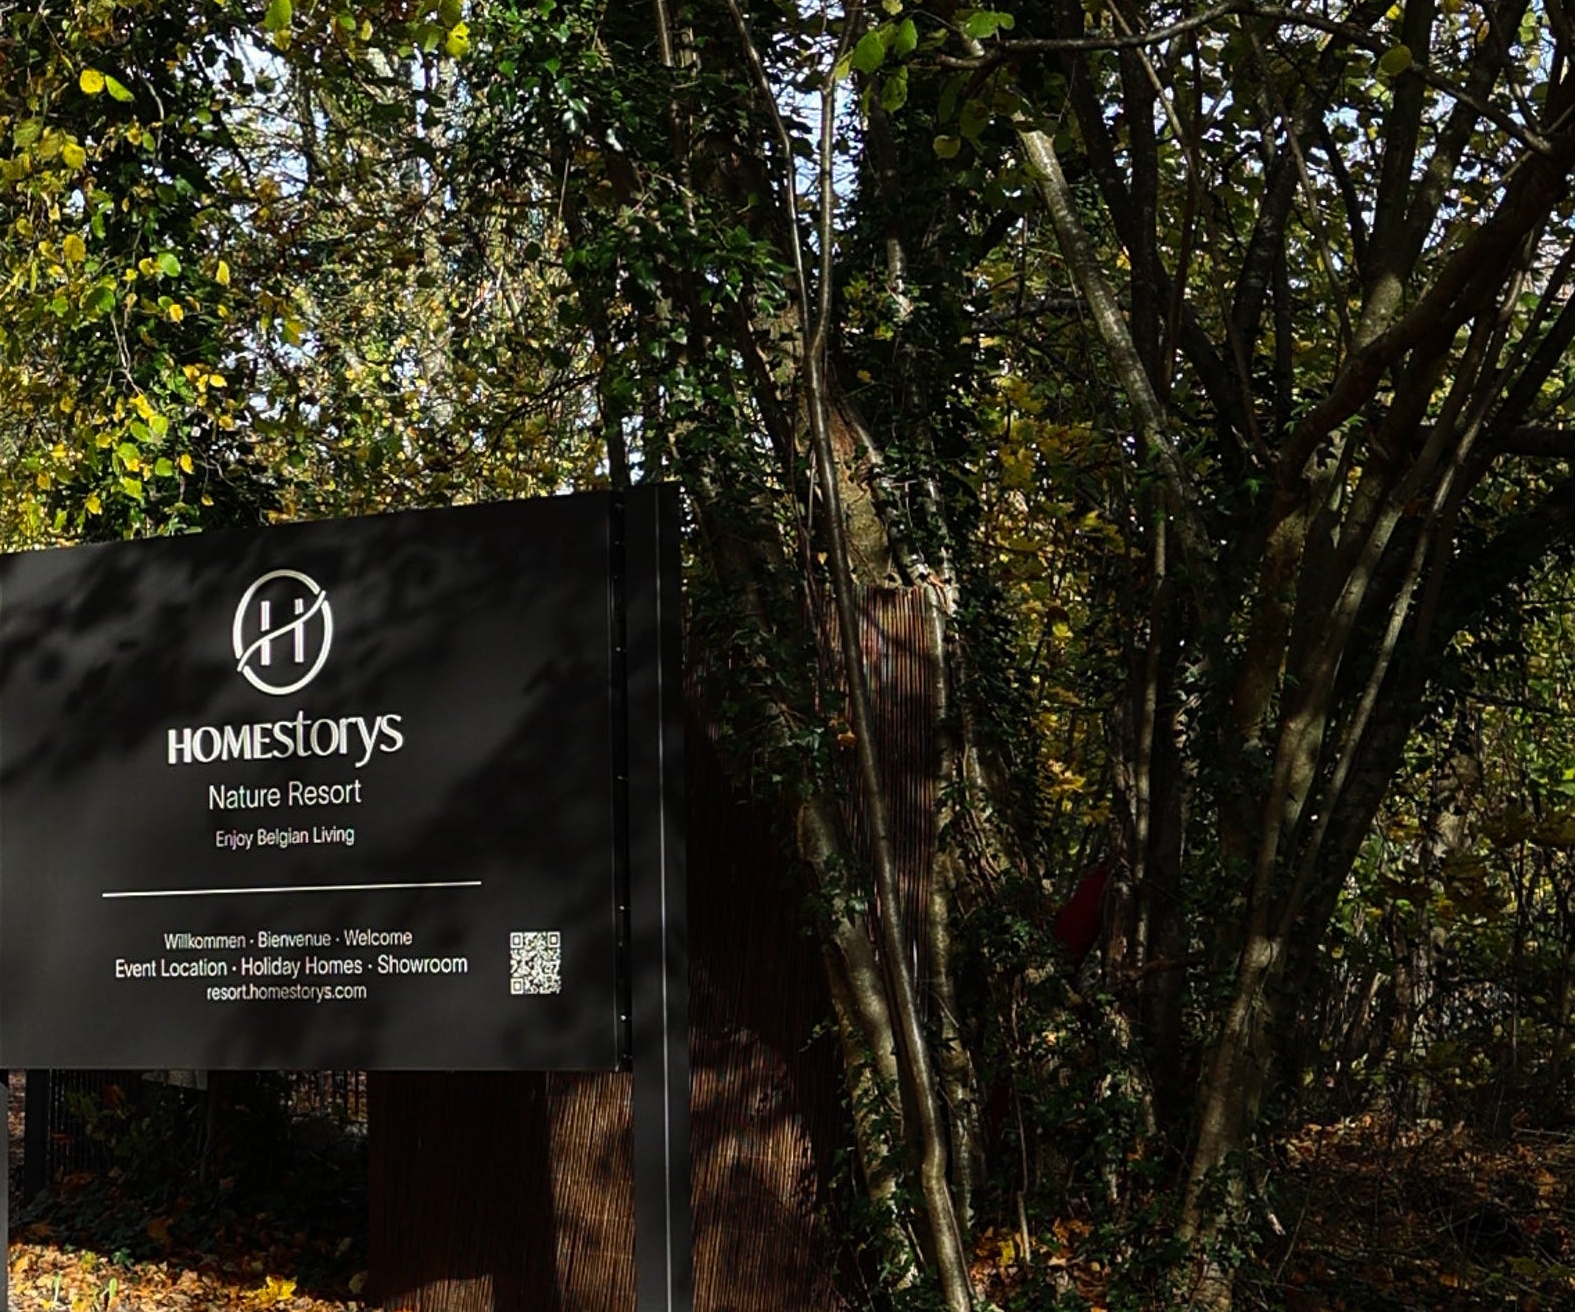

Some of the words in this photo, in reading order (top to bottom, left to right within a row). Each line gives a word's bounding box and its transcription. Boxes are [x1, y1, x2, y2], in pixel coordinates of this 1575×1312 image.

[208, 784, 281, 810] Nature
[288, 779, 362, 806] Resort
[216, 830, 254, 851] Enjoy
[257, 827, 309, 849] Belgian
[313, 825, 355, 846] Living
[163, 933, 246, 950] Willkommen
[257, 930, 332, 948] Bienvenue
[344, 928, 413, 946] Welcome
[115, 958, 157, 978] Event
[161, 958, 228, 977] Location
[241, 956, 301, 979] Holiday
[305, 956, 363, 975] Homes
[377, 954, 468, 974] Showroom
[206, 983, 367, 1003] resort.homestorys.com
